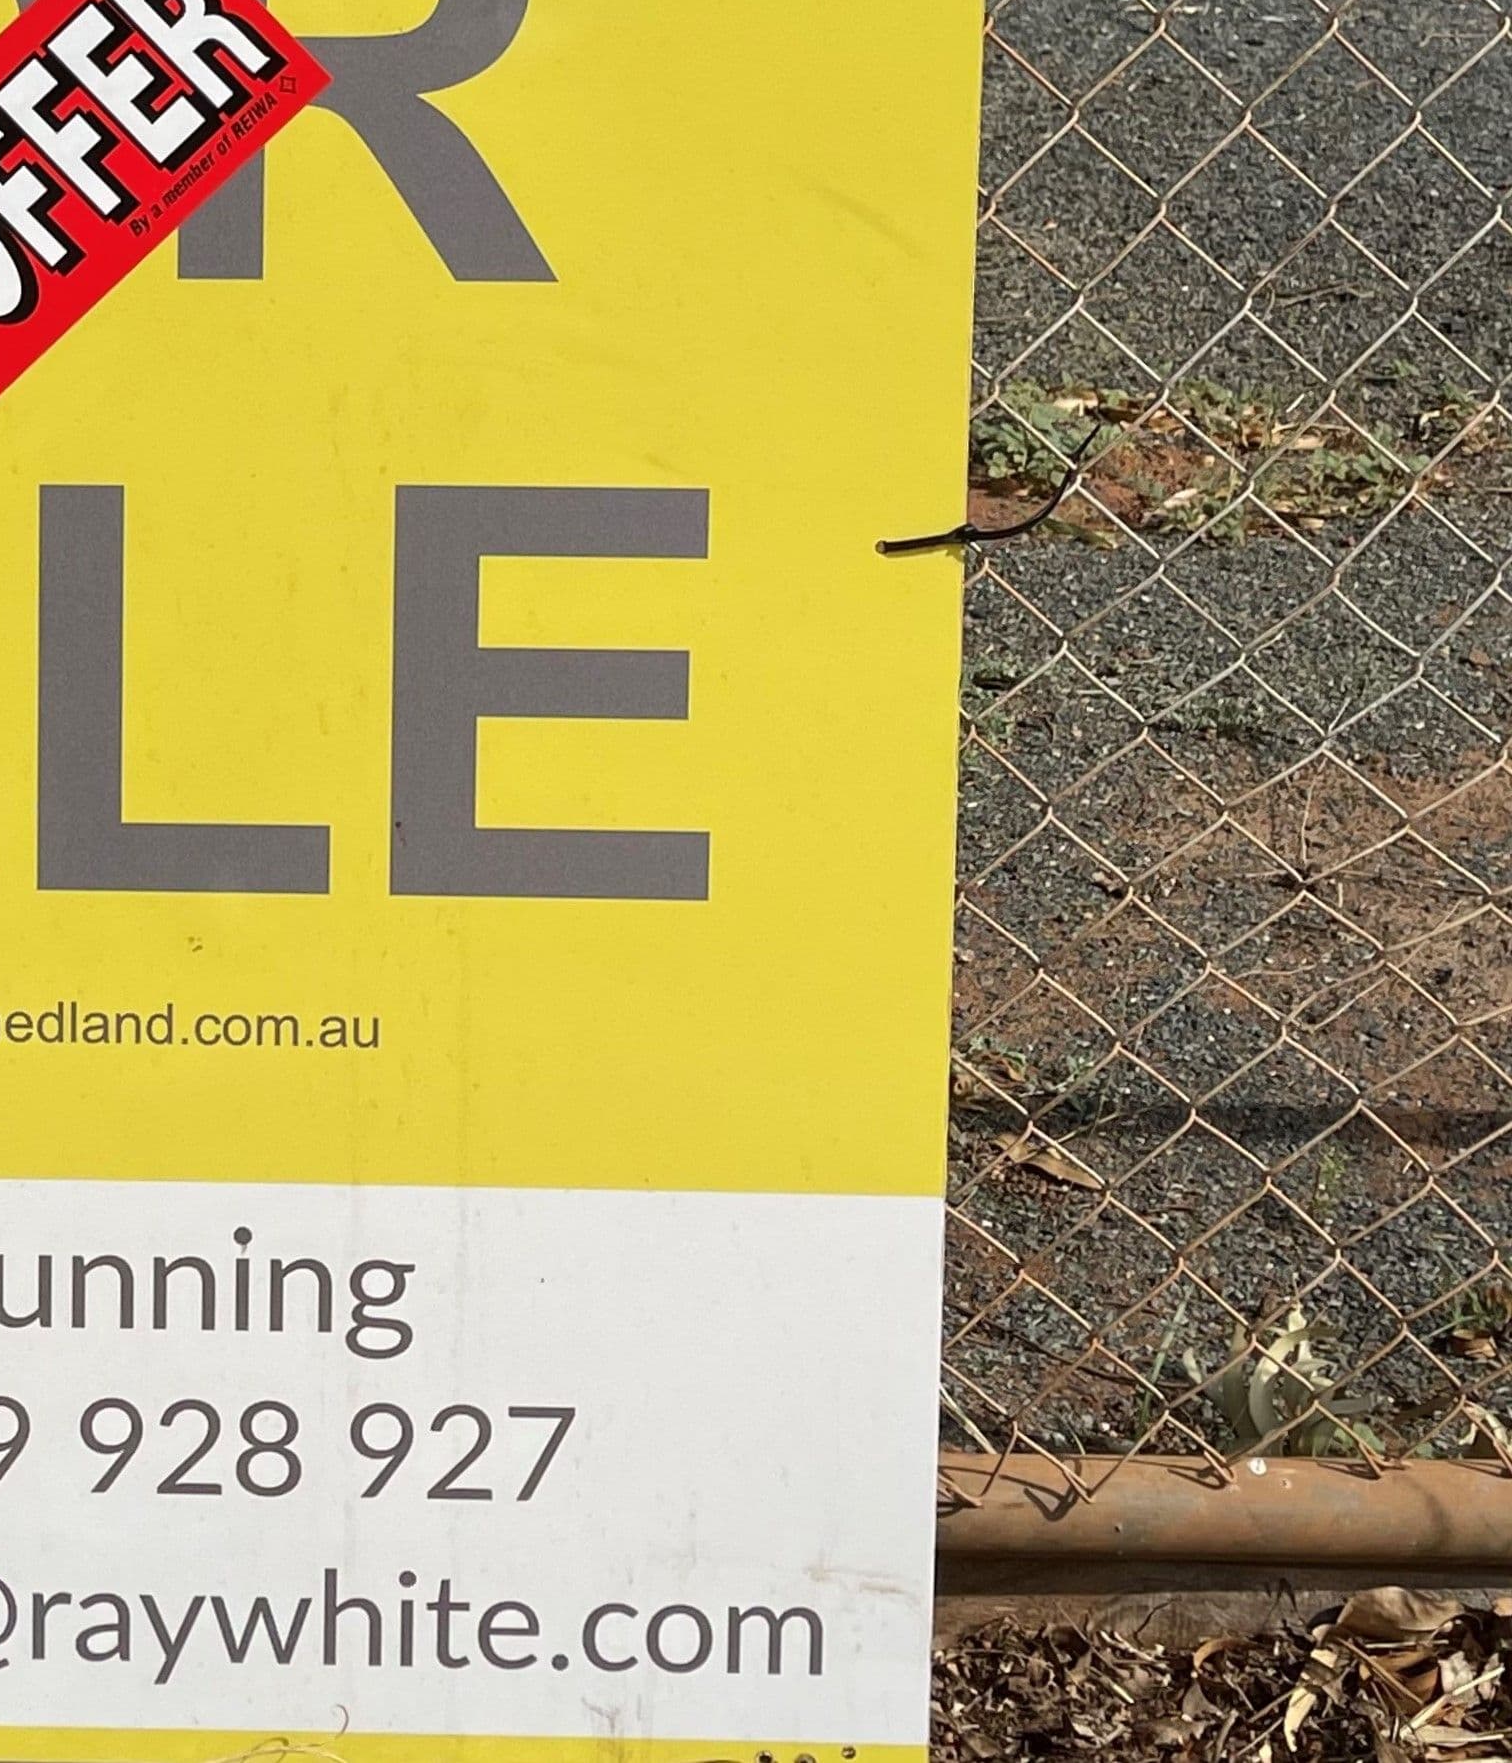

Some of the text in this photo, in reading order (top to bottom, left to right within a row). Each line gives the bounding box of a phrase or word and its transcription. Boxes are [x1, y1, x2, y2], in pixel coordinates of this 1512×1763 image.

[128, 91, 278, 238] By a member of REIWA
[78, 1396, 303, 1498] 928
[349, 1401, 577, 1503] 927
